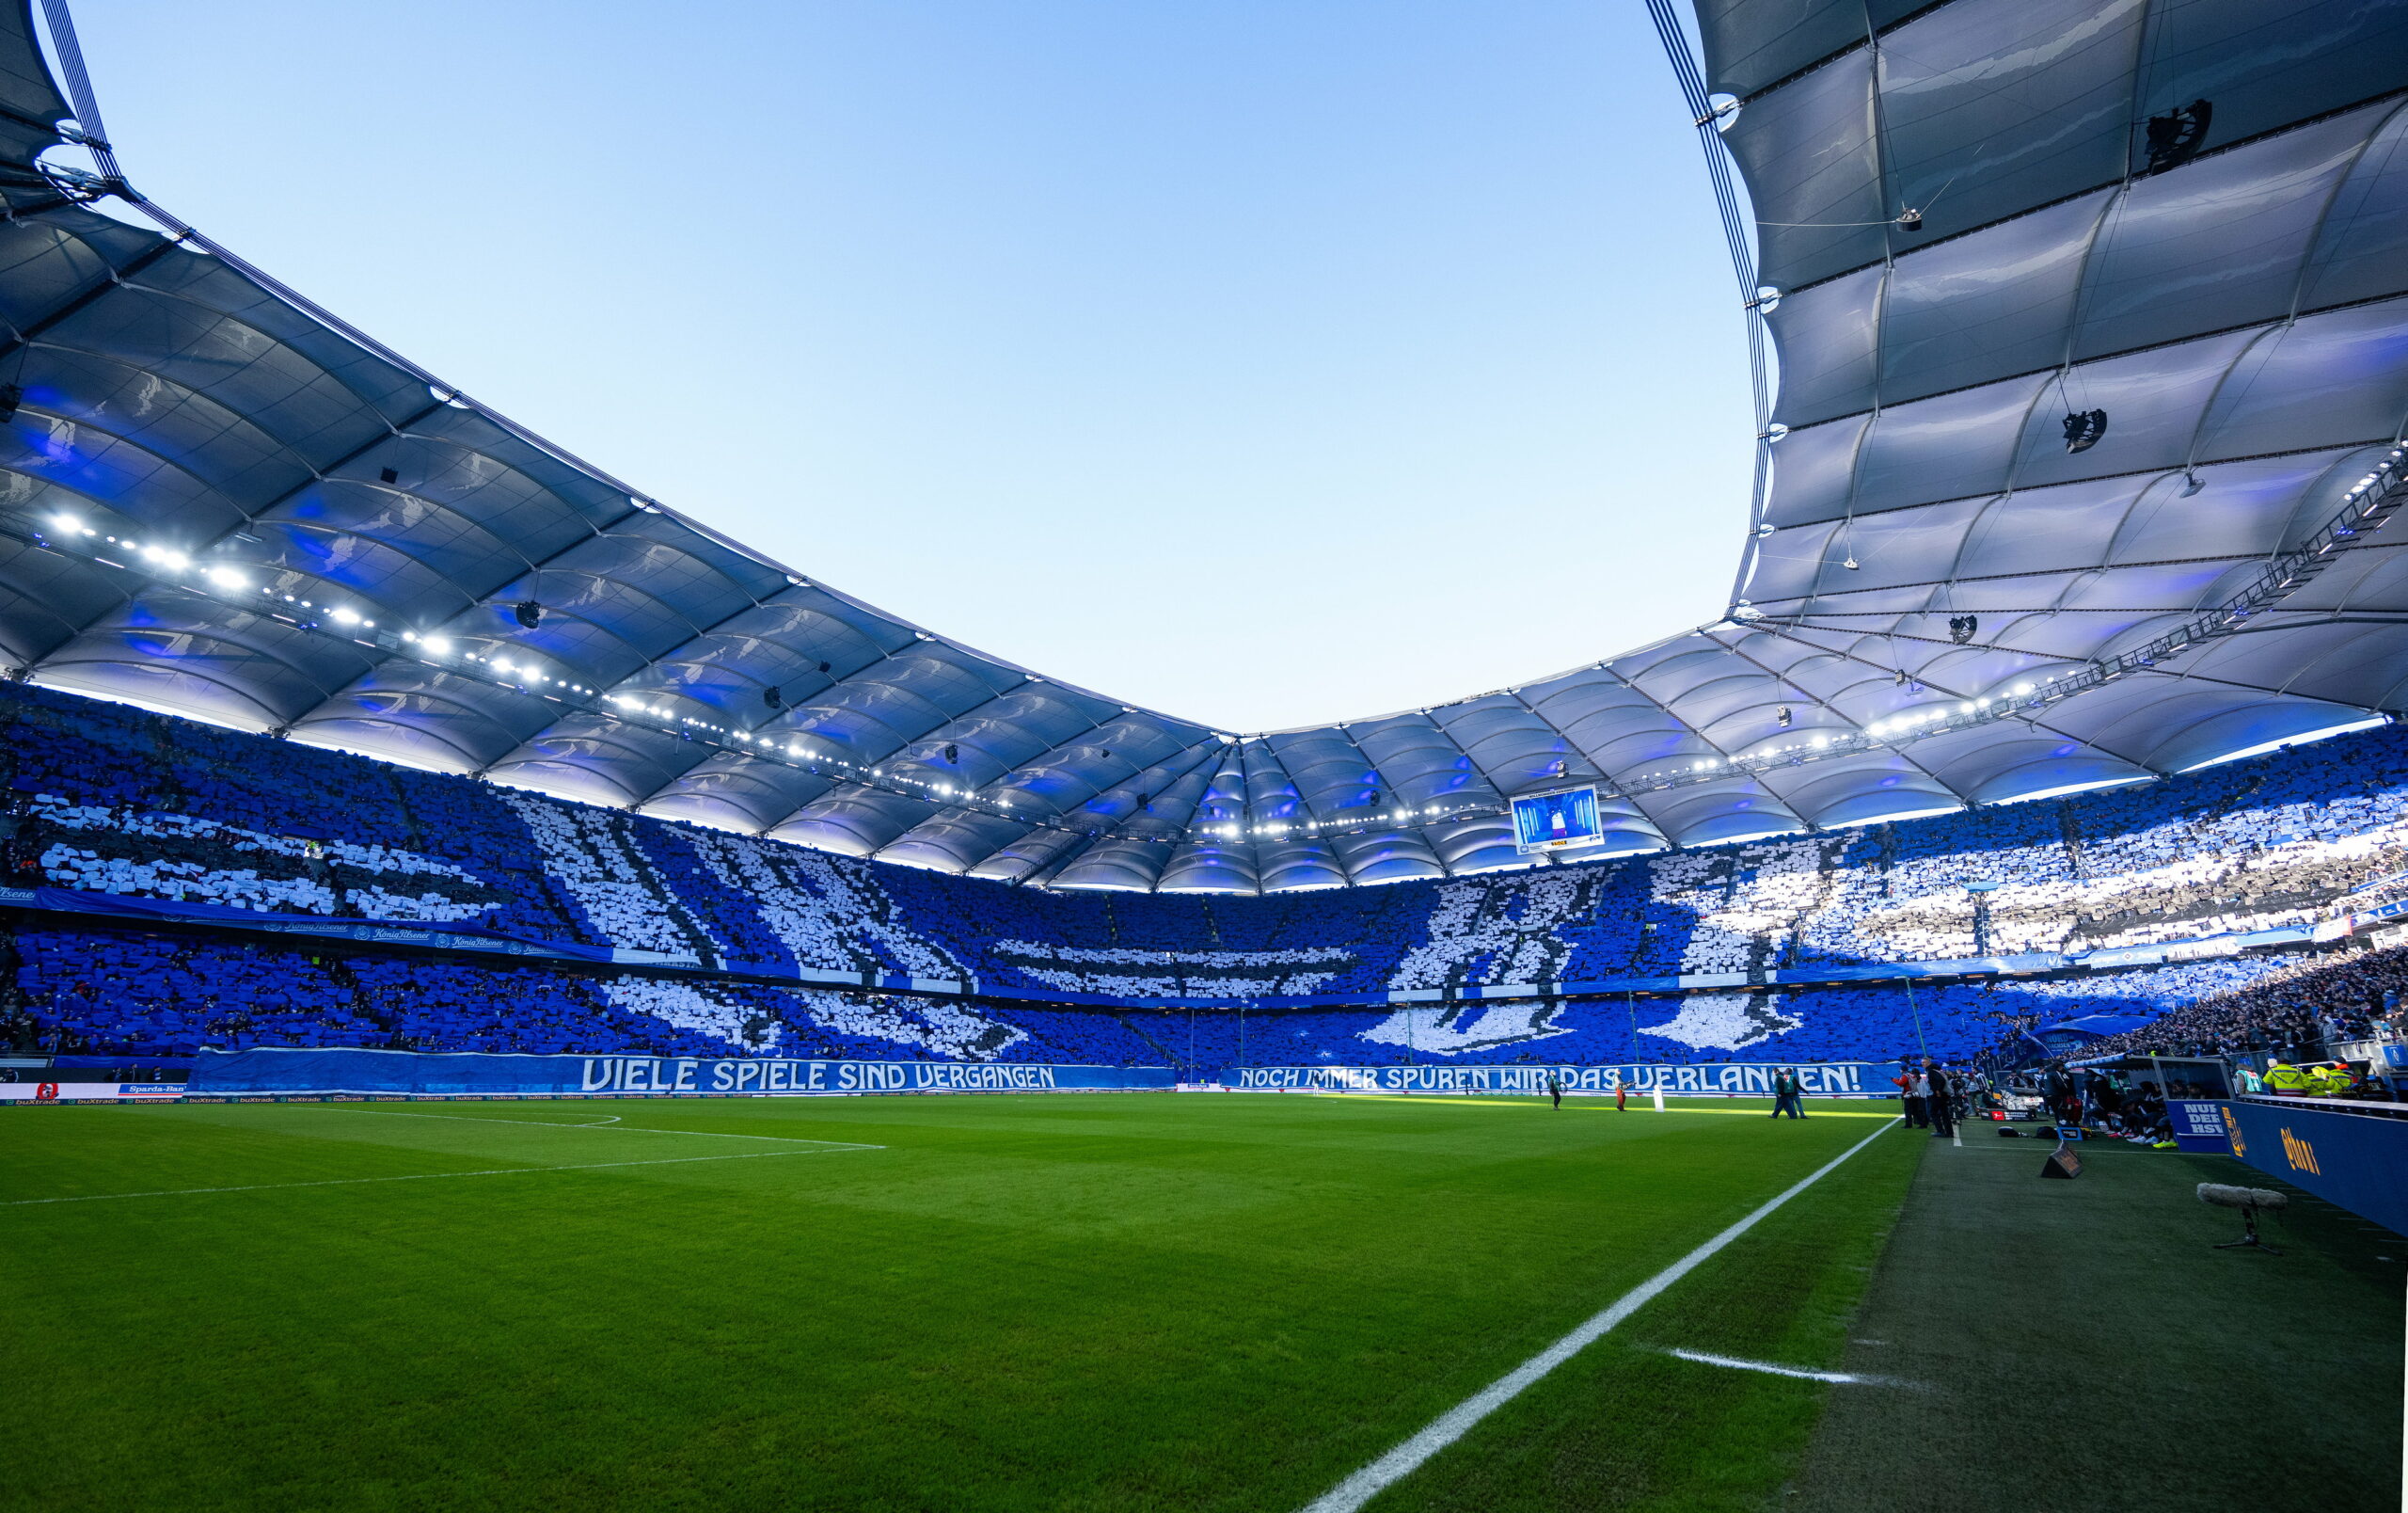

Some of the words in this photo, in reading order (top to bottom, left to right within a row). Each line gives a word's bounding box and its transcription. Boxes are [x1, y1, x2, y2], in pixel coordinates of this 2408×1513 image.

[375, 930, 399, 940] König
[397, 931, 430, 940] Pilsener
[453, 936, 476, 947] König
[474, 937, 504, 947] Pilsener
[581, 1059, 699, 1091] VIELE
[712, 1061, 827, 1091] SPIELE
[837, 1064, 906, 1090] SIND
[915, 1064, 1055, 1088] VERGANGEN
[1240, 1069, 1299, 1088] NOCH
[1305, 1068, 1378, 1090] IMMER
[1386, 1064, 1490, 1090] SPÜREN
[1500, 1068, 1548, 1090] WIR
[1560, 1067, 1617, 1091] DAS
[1633, 1065, 1861, 1091] VERLANEN!
[129, 1084, 187, 1094] Sparda-Ban
